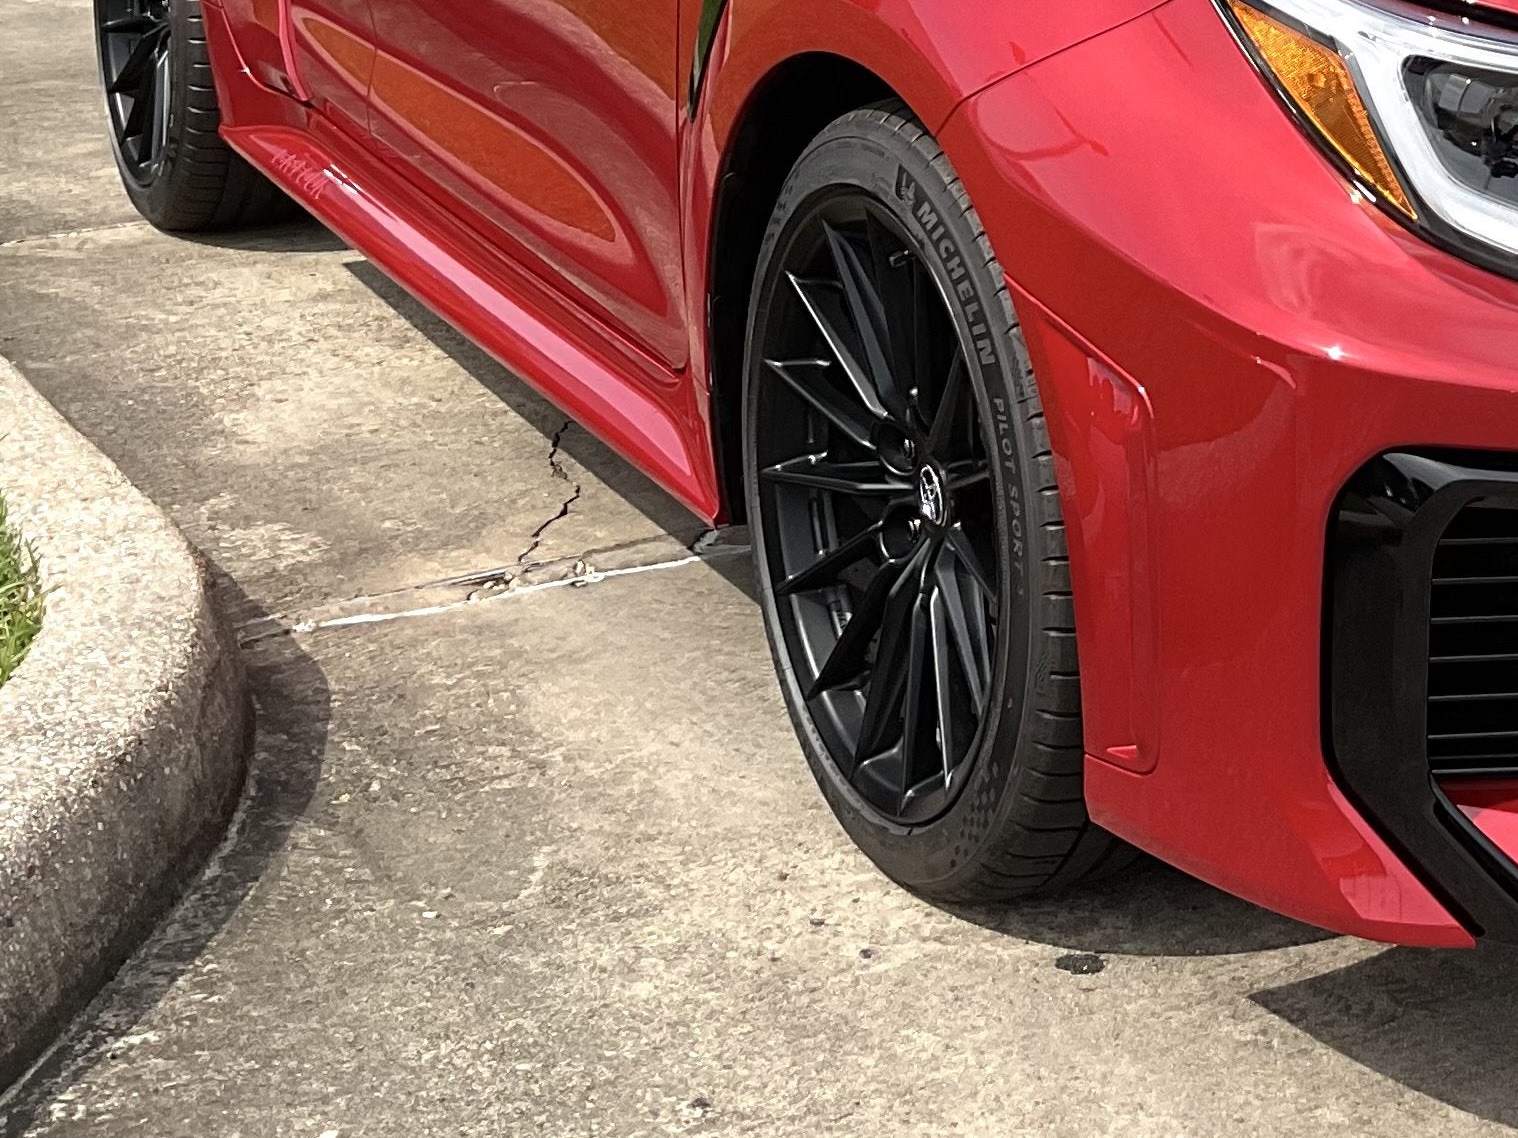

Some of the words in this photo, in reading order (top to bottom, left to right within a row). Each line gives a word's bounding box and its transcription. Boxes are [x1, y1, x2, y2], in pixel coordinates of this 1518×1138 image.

[917, 201, 995, 365] MICHELIN
[993, 398, 1016, 474] PILOT
[1008, 483, 1024, 577] SPORT
